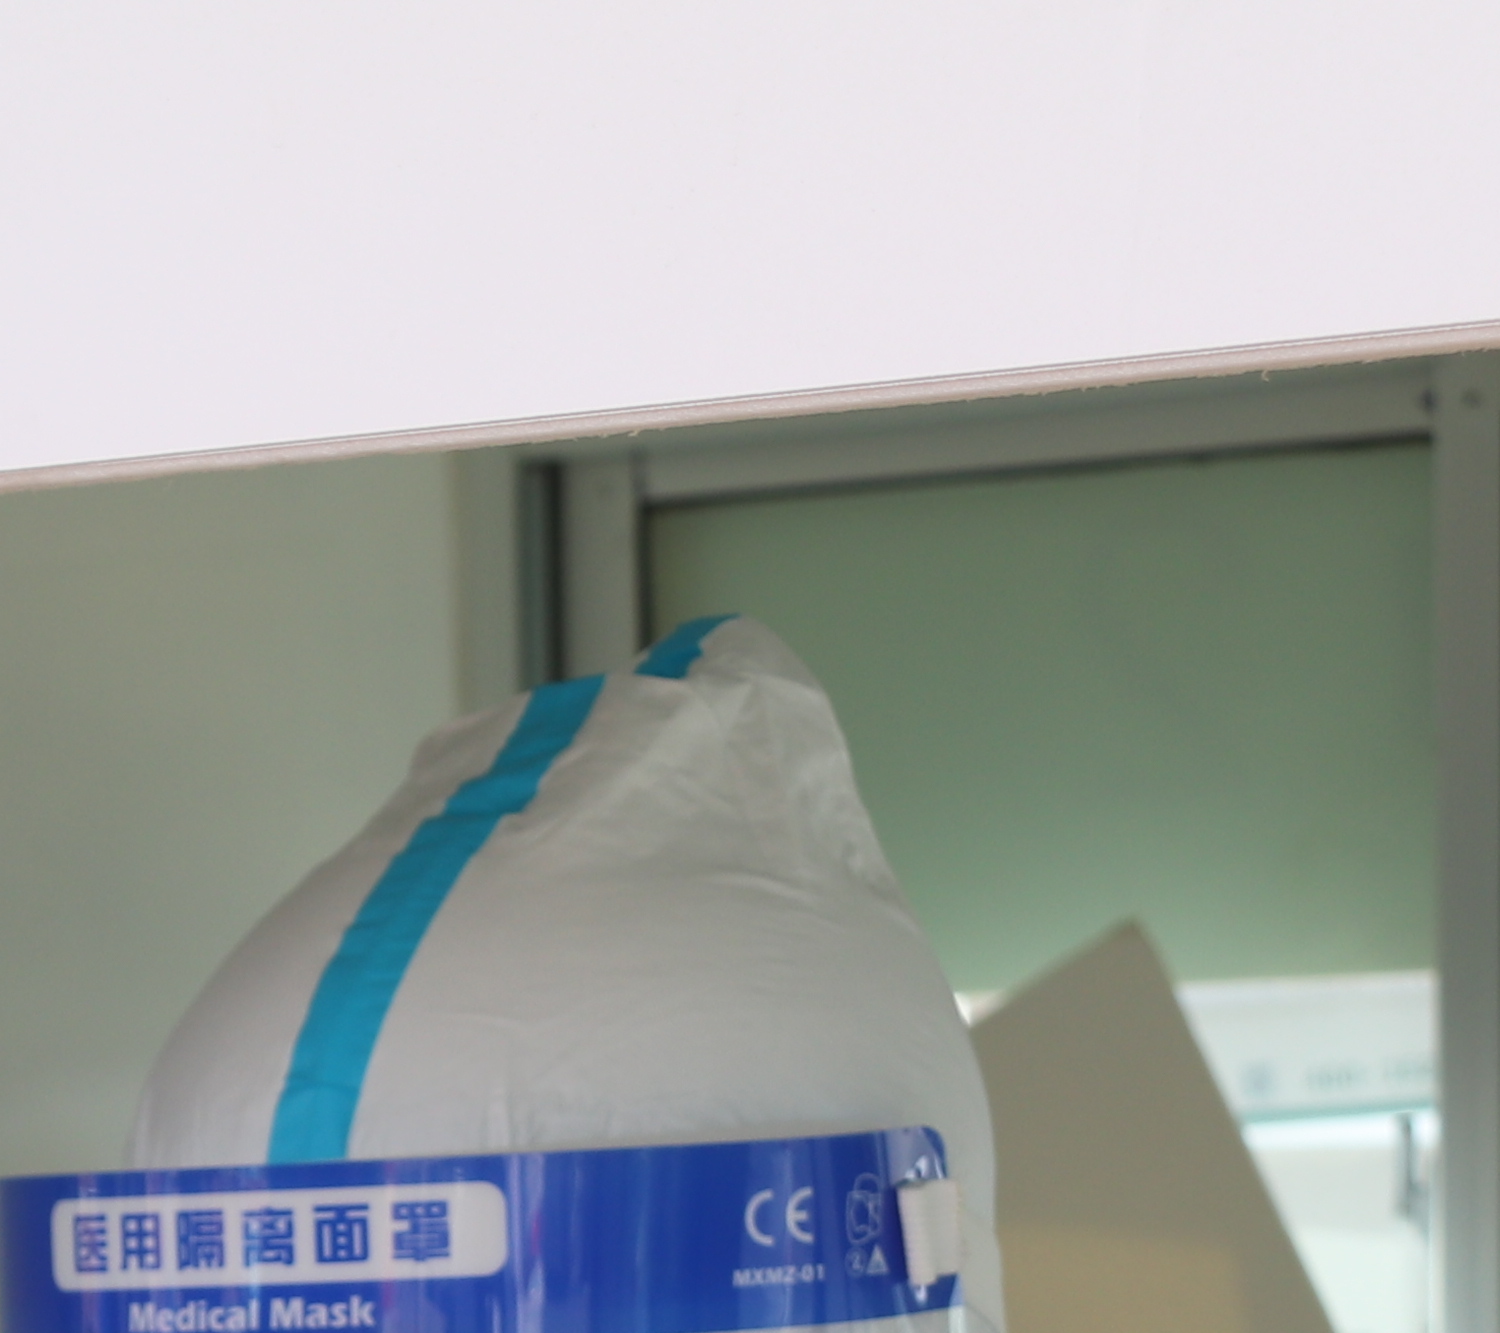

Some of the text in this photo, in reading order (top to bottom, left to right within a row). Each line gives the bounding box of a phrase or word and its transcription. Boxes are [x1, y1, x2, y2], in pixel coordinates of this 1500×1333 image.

[74, 1200, 452, 1272] 医用隔离面罩
[744, 1186, 814, 1247] CE
[128, 1294, 375, 1333] Medical Mask
